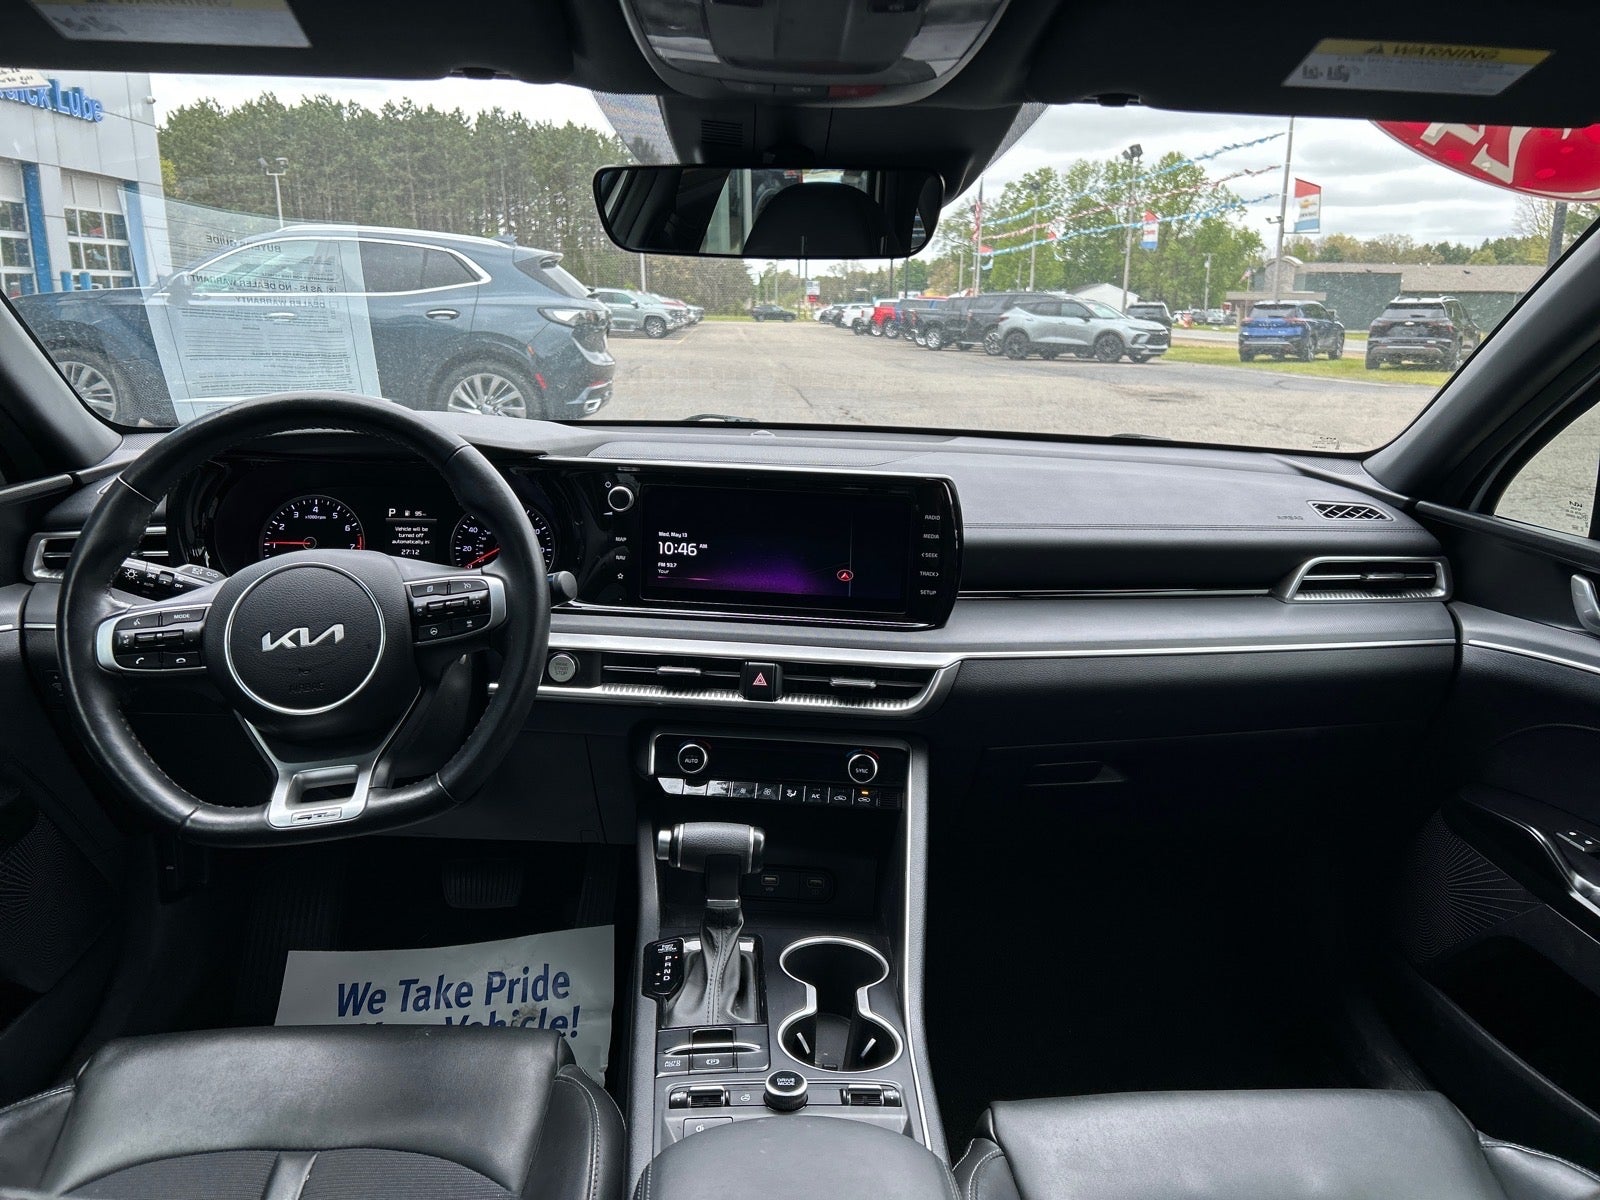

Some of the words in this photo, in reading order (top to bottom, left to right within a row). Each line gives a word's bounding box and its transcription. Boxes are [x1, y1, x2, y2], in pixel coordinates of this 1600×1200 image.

[1394, 45, 1498, 60] WARNING
[54, 79, 103, 122] Lube
[293, 511, 299, 519] 3
[388, 508, 396, 517] P
[279, 523, 285, 531] 2
[344, 524, 351, 532] 6
[658, 541, 697, 556] 10:46
[262, 624, 344, 652] KIA
[338, 981, 387, 1017] We
[398, 974, 474, 1013] Take
[484, 963, 570, 1006] Pride
